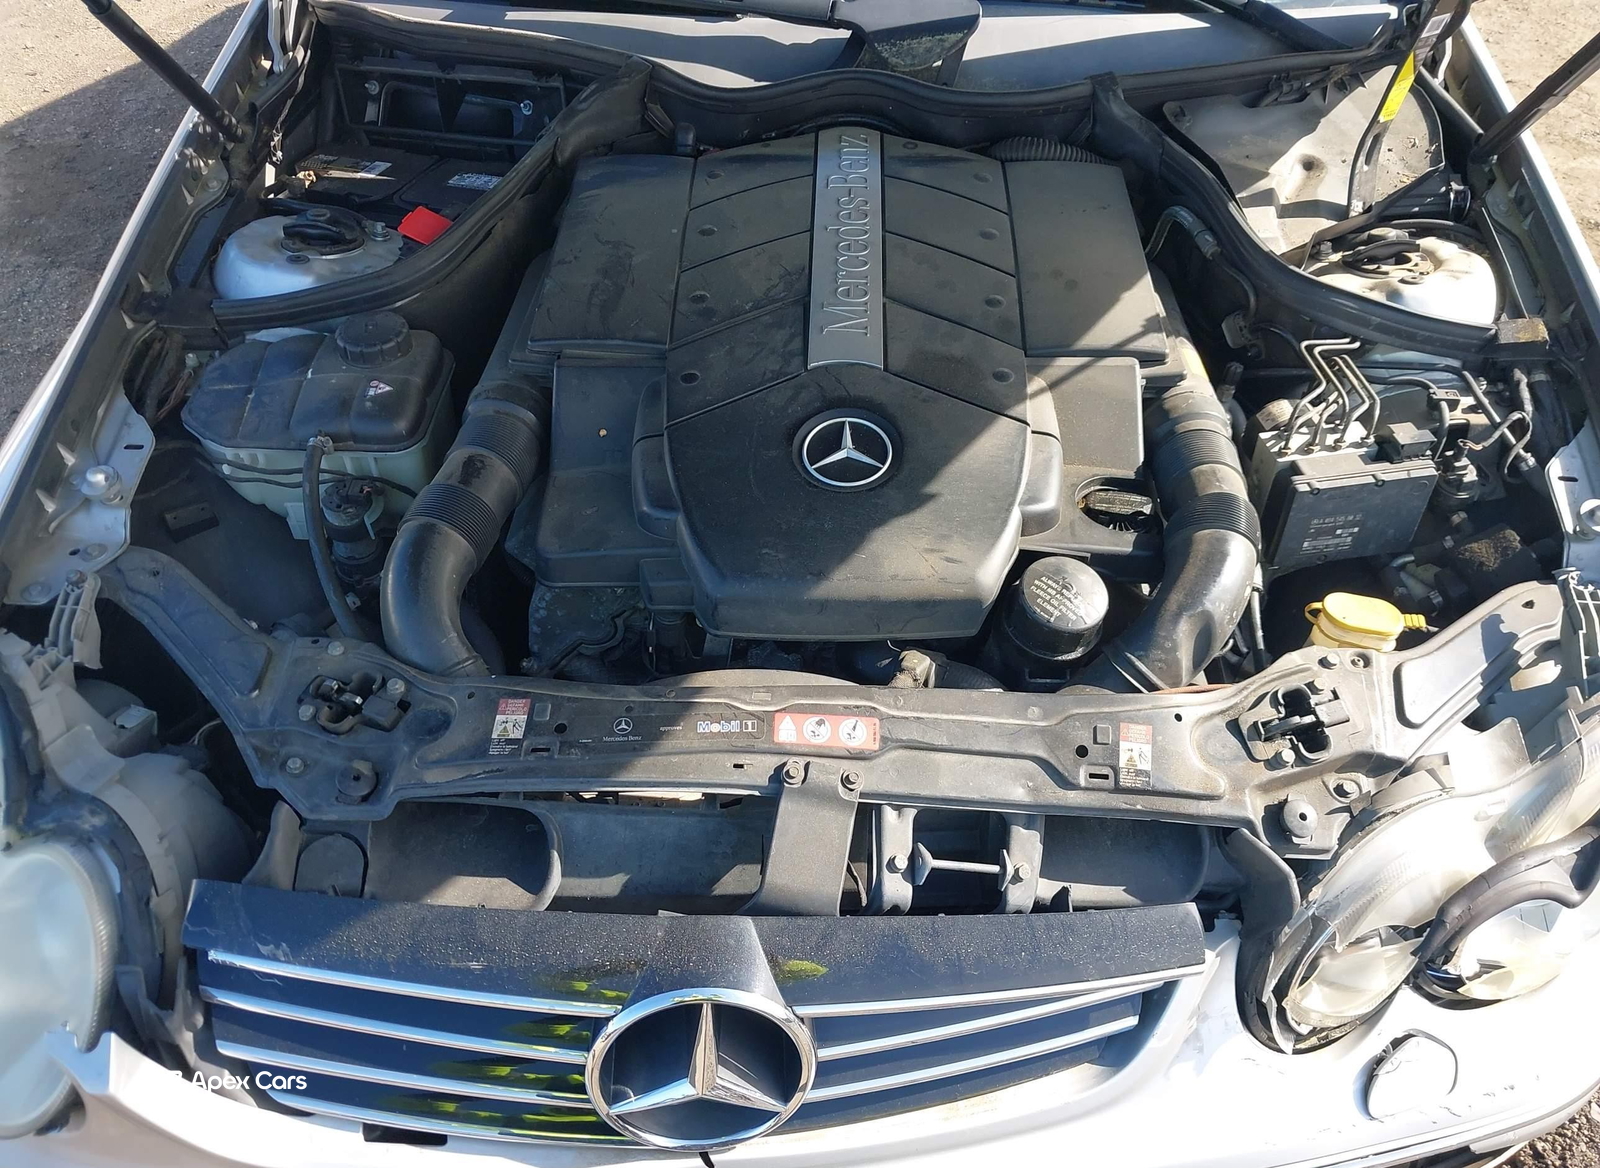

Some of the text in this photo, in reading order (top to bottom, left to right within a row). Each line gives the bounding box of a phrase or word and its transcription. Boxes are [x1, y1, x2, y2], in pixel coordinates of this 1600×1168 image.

[821, 134, 871, 337] Mercedes-Benz
[1034, 579, 1047, 590] WITH
[1041, 576, 1063, 591] ALWAYS
[1030, 585, 1051, 601] FLEECE
[1050, 598, 1059, 607] OIL
[1059, 604, 1078, 621] FILTER
[1036, 598, 1061, 617] ELEMENT
[697, 720, 756, 733] Mobil 1
